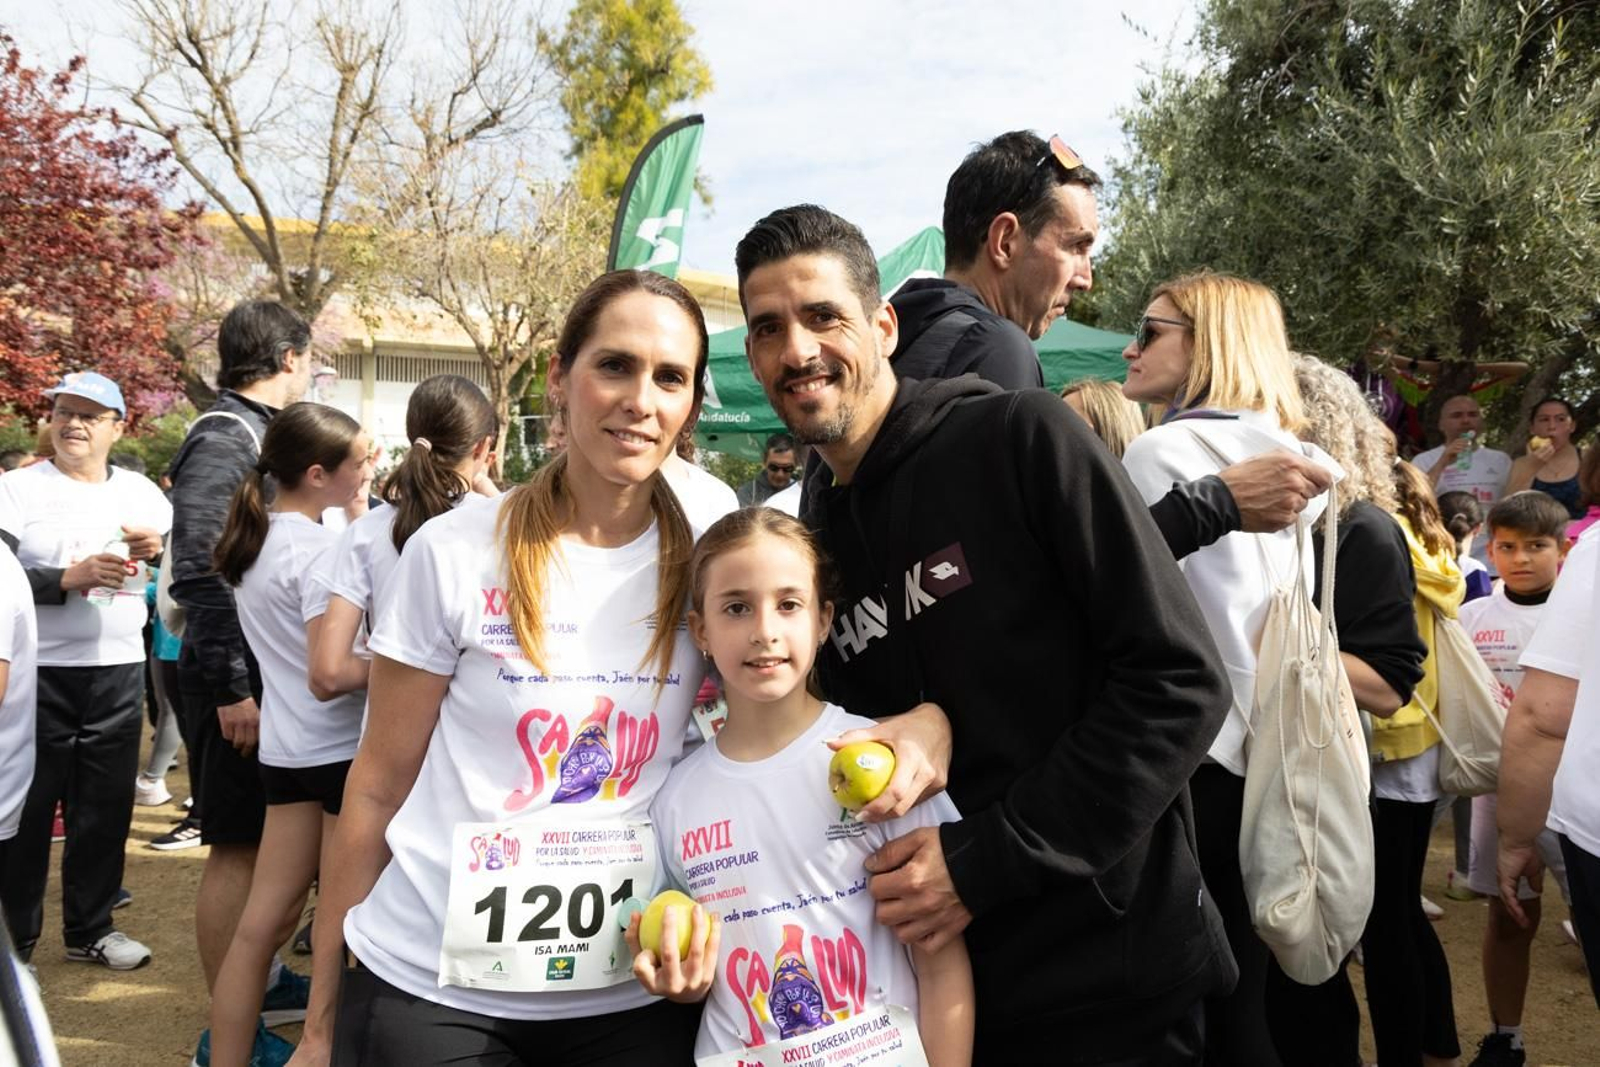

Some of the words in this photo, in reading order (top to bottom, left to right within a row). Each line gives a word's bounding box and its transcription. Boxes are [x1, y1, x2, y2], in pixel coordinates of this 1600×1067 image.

[481, 624, 515, 635] CARRE
[528, 671, 549, 682] cada
[612, 670, 634, 684] Jaén
[637, 675, 651, 685] por
[503, 707, 660, 812] SALUD
[469, 832, 521, 872] SALUD
[536, 847, 549, 856] POR
[551, 847, 558, 856] LA
[559, 847, 580, 856] SALUD
[541, 832, 571, 844] XXVII
[571, 831, 607, 844] CARRERA
[681, 819, 733, 862] XXVII
[715, 850, 759, 871] POPULAR
[723, 909, 740, 923] cada
[742, 909, 759, 921] paso
[761, 901, 796, 916] cuenta,
[796, 894, 818, 908] Jaén
[836, 890, 846, 900] tu
[848, 877, 868, 896] salud
[535, 945, 552, 955] ISA
[557, 943, 589, 954] MAMI
[726, 927, 867, 1048] SALUD
[781, 1045, 811, 1063] XXVII
[811, 1031, 850, 1055] CARRERA
[850, 1014, 891, 1040] POPULAR
